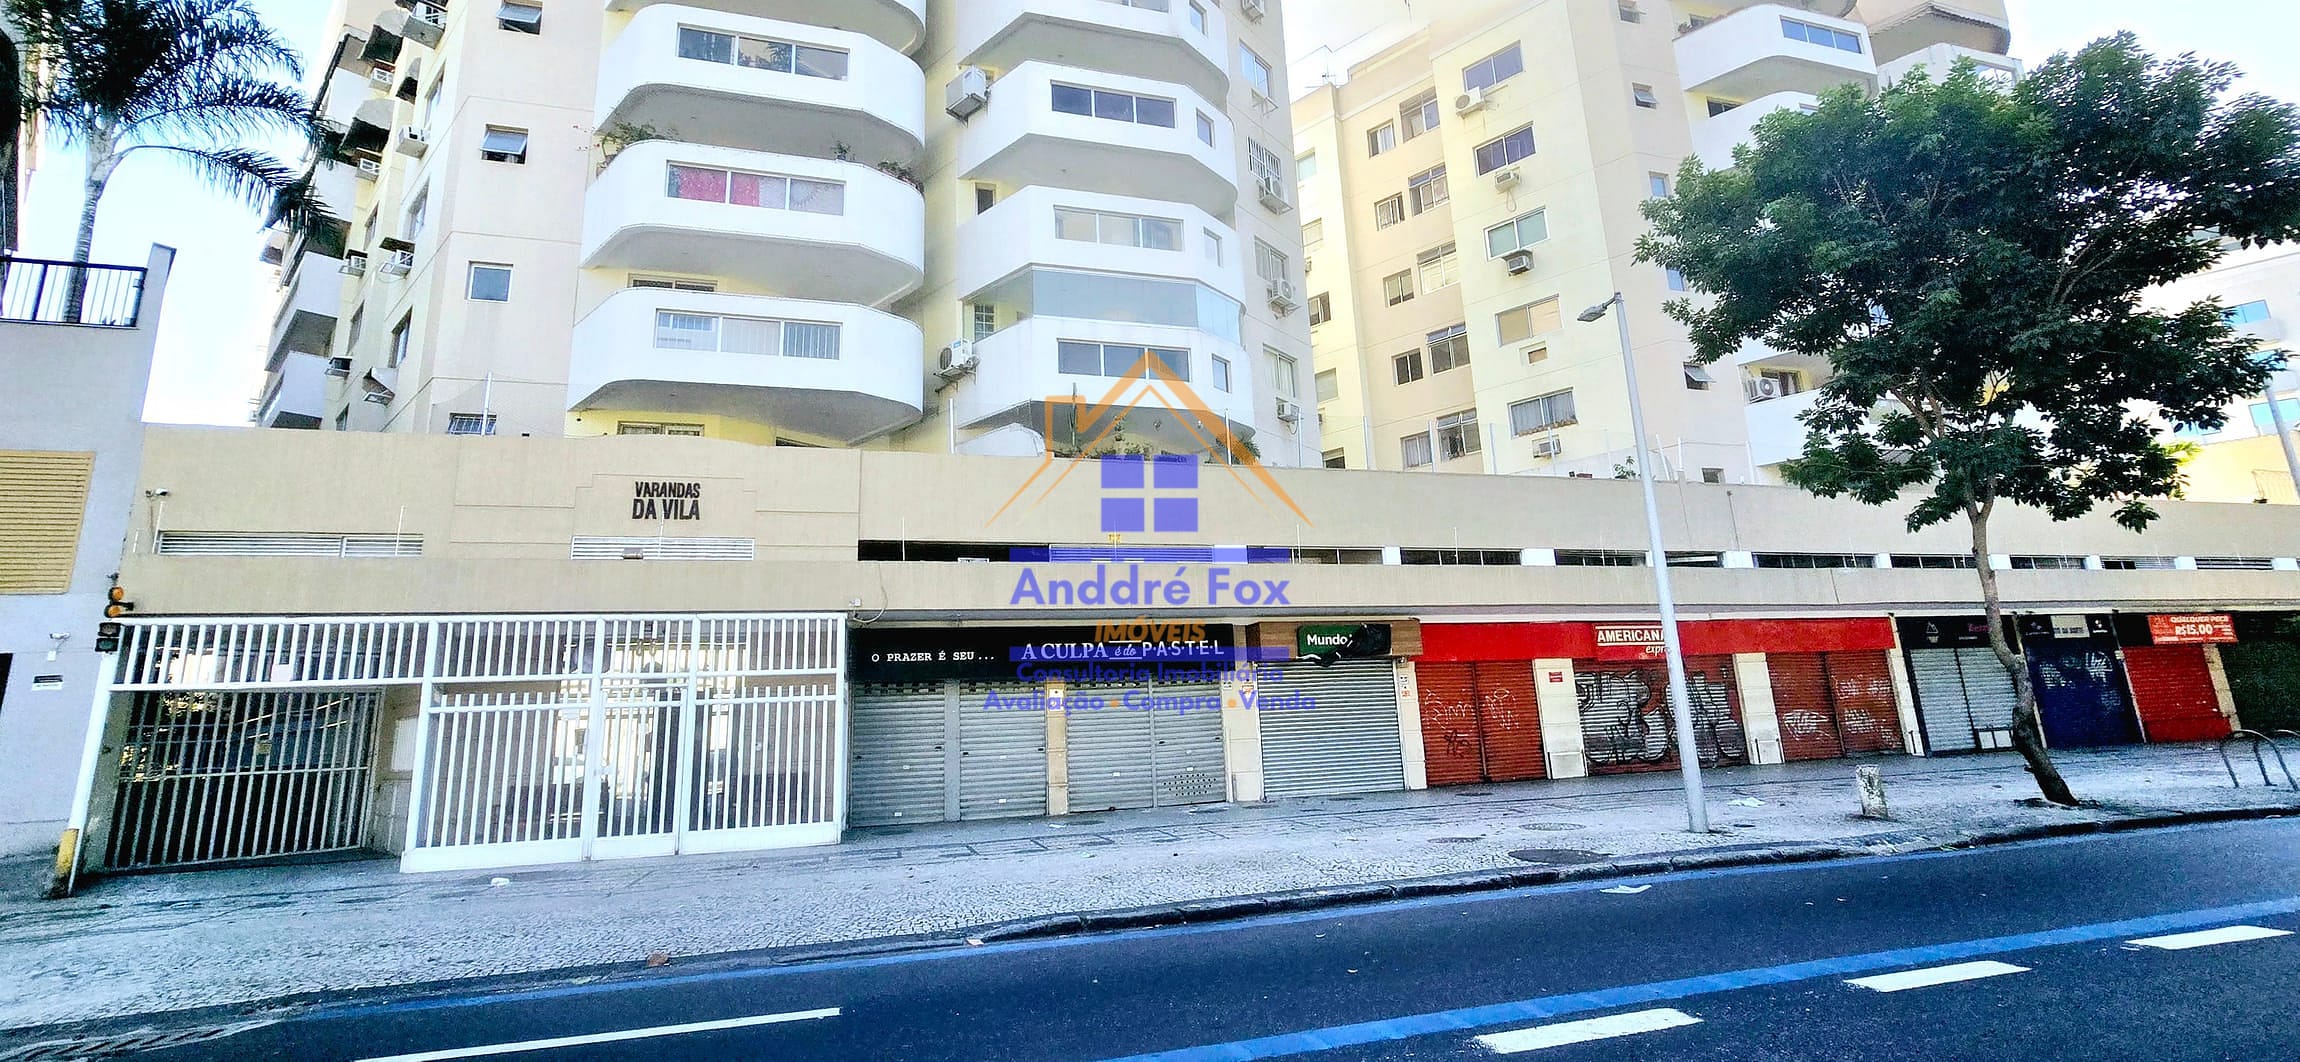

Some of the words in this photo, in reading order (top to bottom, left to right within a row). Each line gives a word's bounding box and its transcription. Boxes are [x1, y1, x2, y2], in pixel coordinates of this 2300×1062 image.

[635, 481, 701, 498] VARANDAS
[632, 498, 657, 520] DA
[662, 498, 700, 520] VILA
[1306, 633, 1348, 646] Mundo
[871, 653, 880, 662] O
[887, 652, 932, 662] PRAZER
[938, 650, 946, 661] É
[1021, 643, 1036, 660] A
[1041, 642, 1109, 660] CULPA
